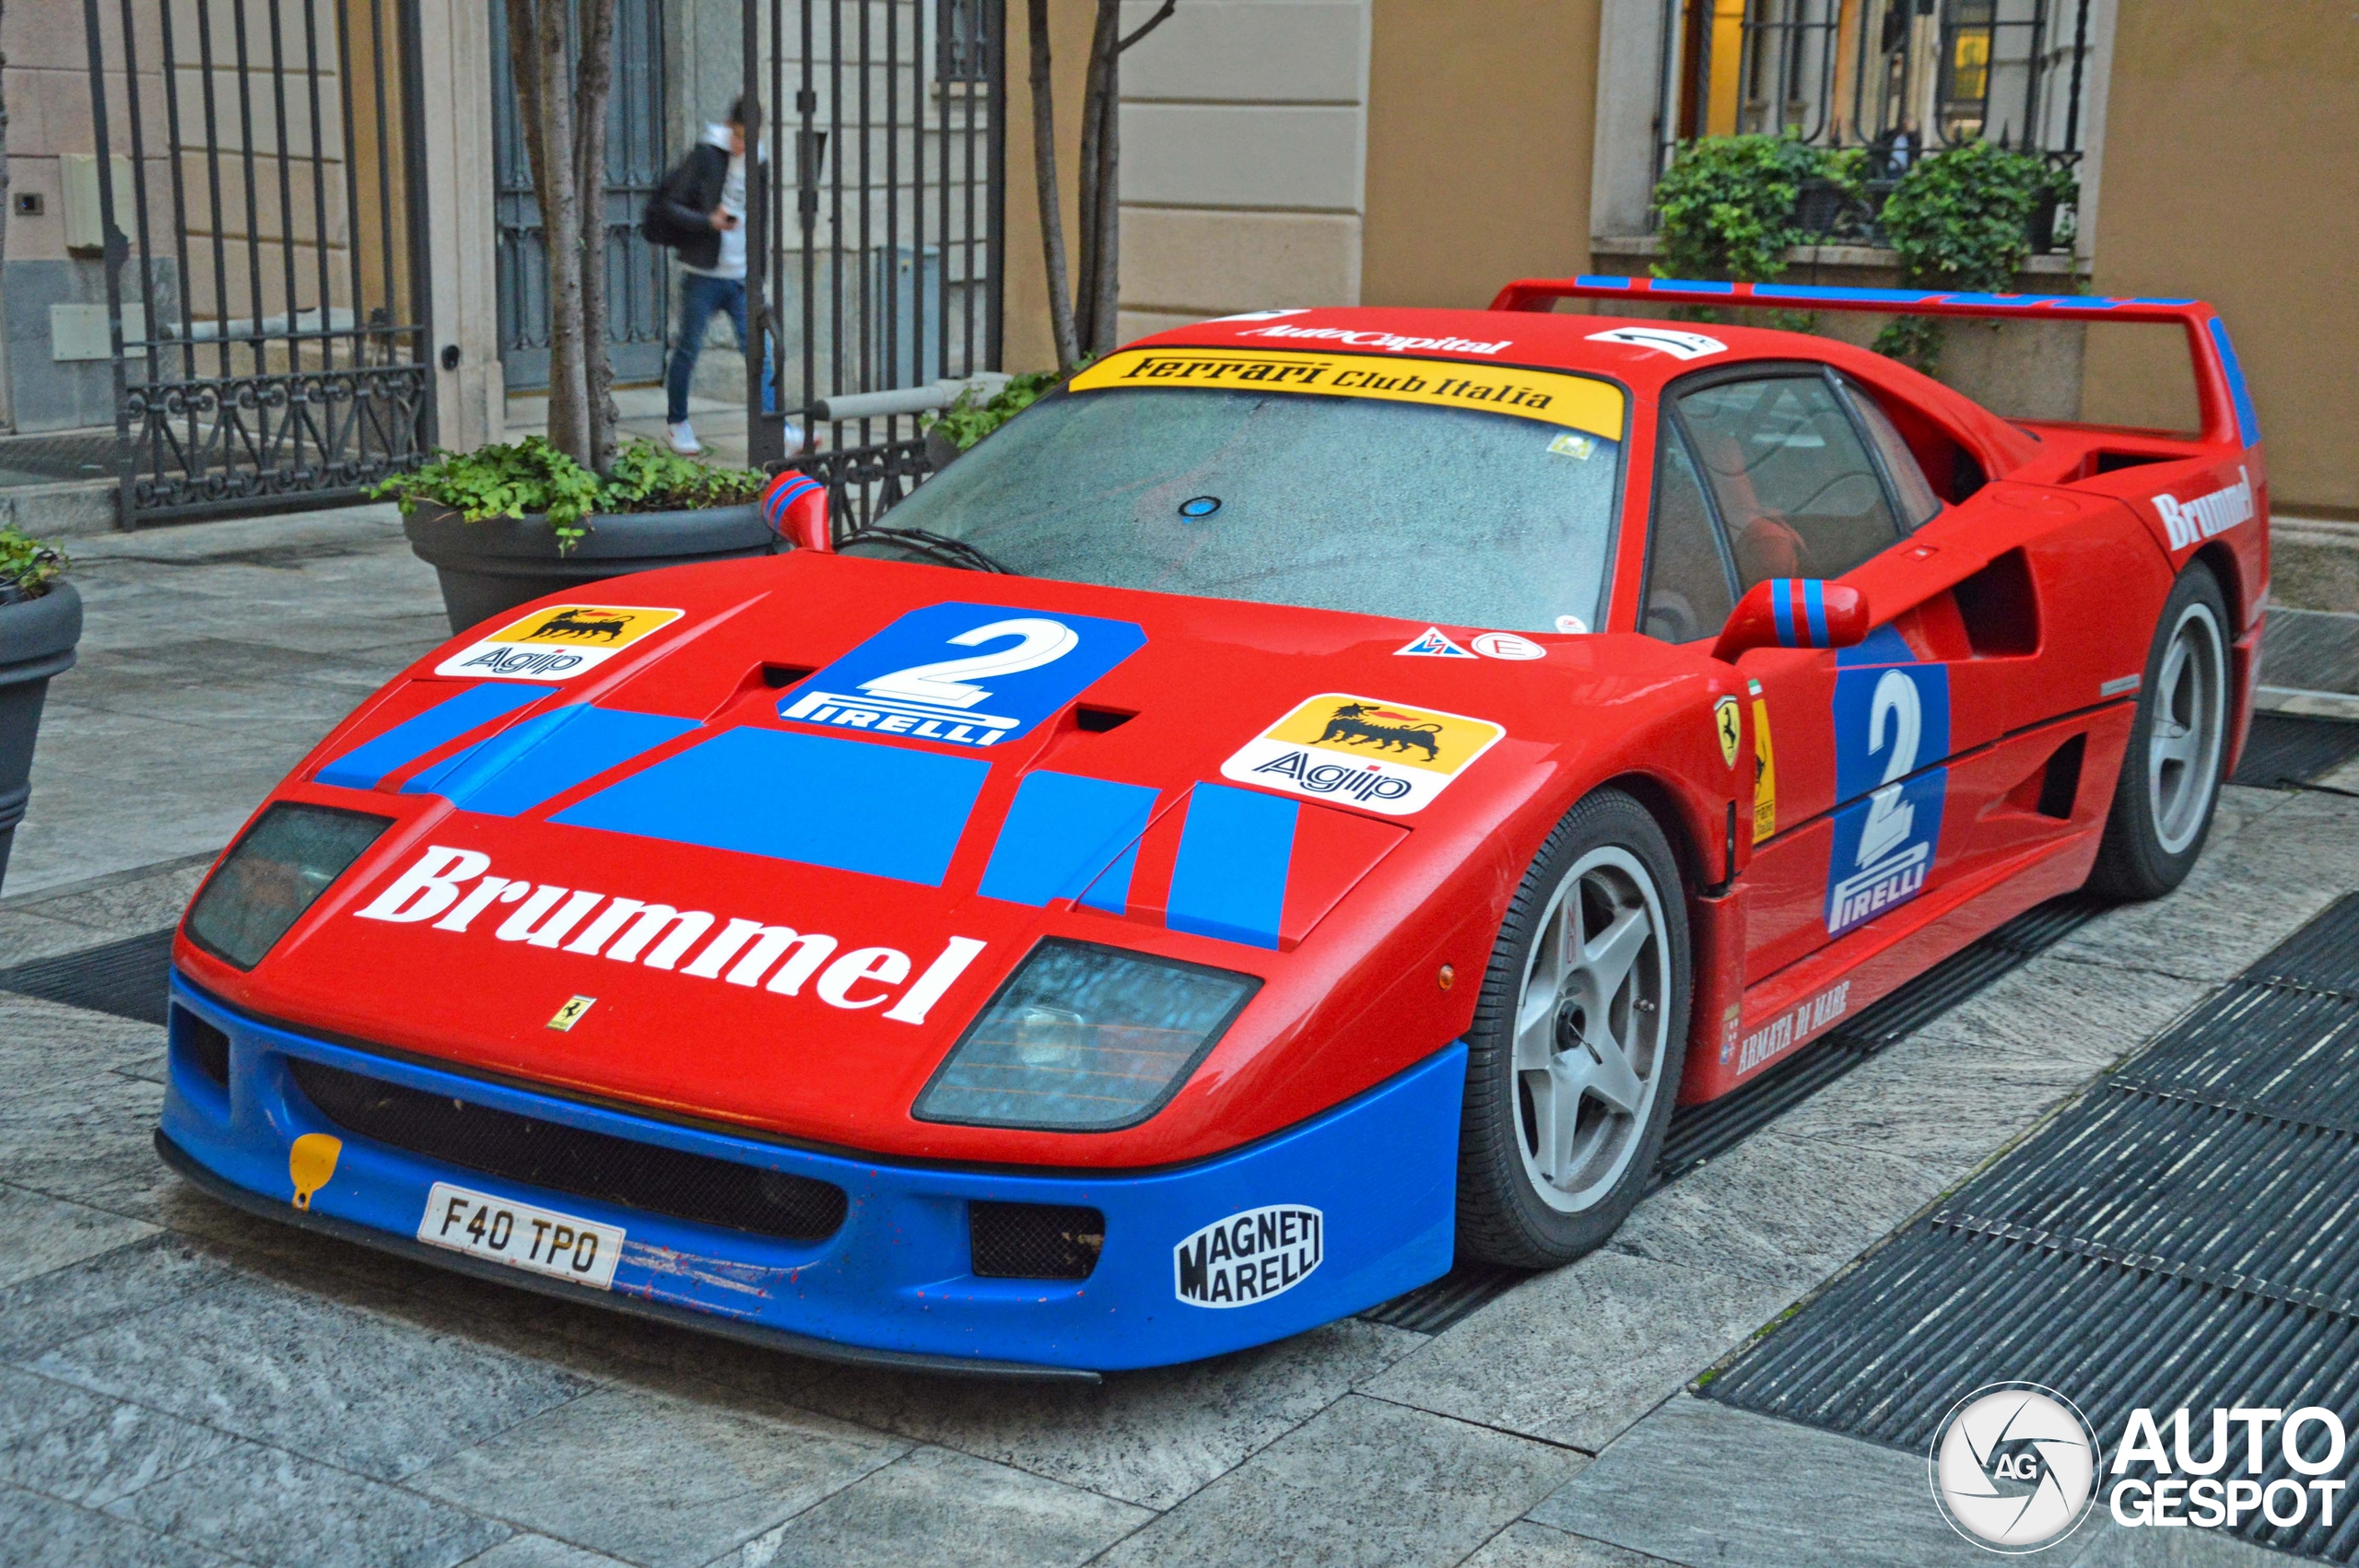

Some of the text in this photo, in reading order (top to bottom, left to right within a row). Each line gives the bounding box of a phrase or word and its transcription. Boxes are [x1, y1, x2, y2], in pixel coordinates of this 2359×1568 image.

[1235, 324, 1513, 354] AutoCapital
[1121, 357, 1554, 410] Ferrari Club Italia
[460, 647, 583, 674] Agip
[856, 617, 1079, 709] 2
[780, 691, 1021, 746] PIRELLI
[1251, 751, 1412, 802] Agip
[1855, 669, 1921, 870] 2
[1828, 840, 1930, 934] PIRELLI
[353, 845, 988, 1025] Brummel
[1737, 1012, 1794, 1076] ARMATA
[440, 1196, 598, 1273] F40 TPO
[1180, 1210, 1320, 1276] MAGNETI
[1180, 1246, 1313, 1303] MARELLI
